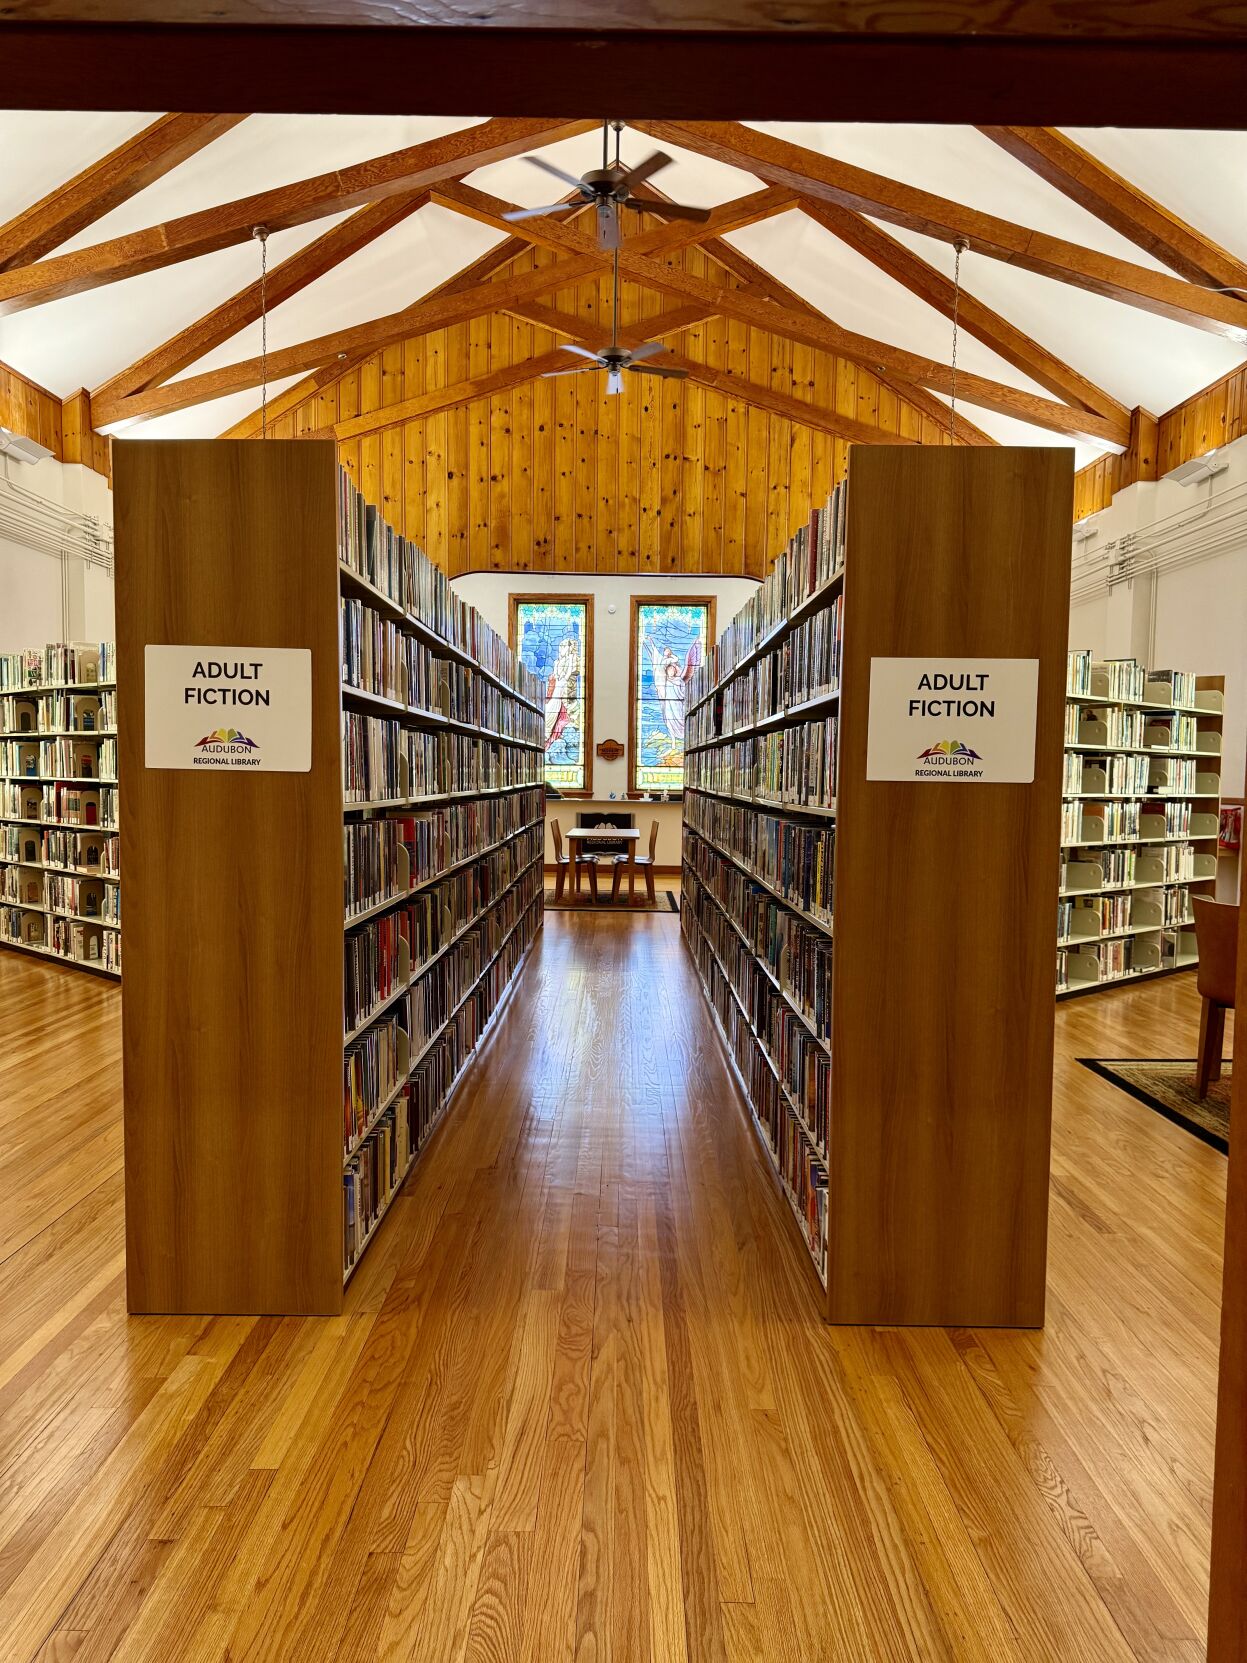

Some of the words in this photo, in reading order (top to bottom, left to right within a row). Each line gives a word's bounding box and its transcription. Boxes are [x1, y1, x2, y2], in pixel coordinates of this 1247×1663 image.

[192, 661, 263, 680] ADULT
[917, 673, 989, 691] ADULT
[184, 687, 270, 706] FICTION
[908, 699, 995, 717] FICTION
[201, 745, 252, 754] AUDUBON
[193, 757, 230, 765] REGIONAL
[231, 758, 261, 766] LIBRARY
[923, 756, 974, 765] AUDUBON
[914, 769, 952, 777] REGIONAL
[953, 770, 983, 778] LIBRARY
